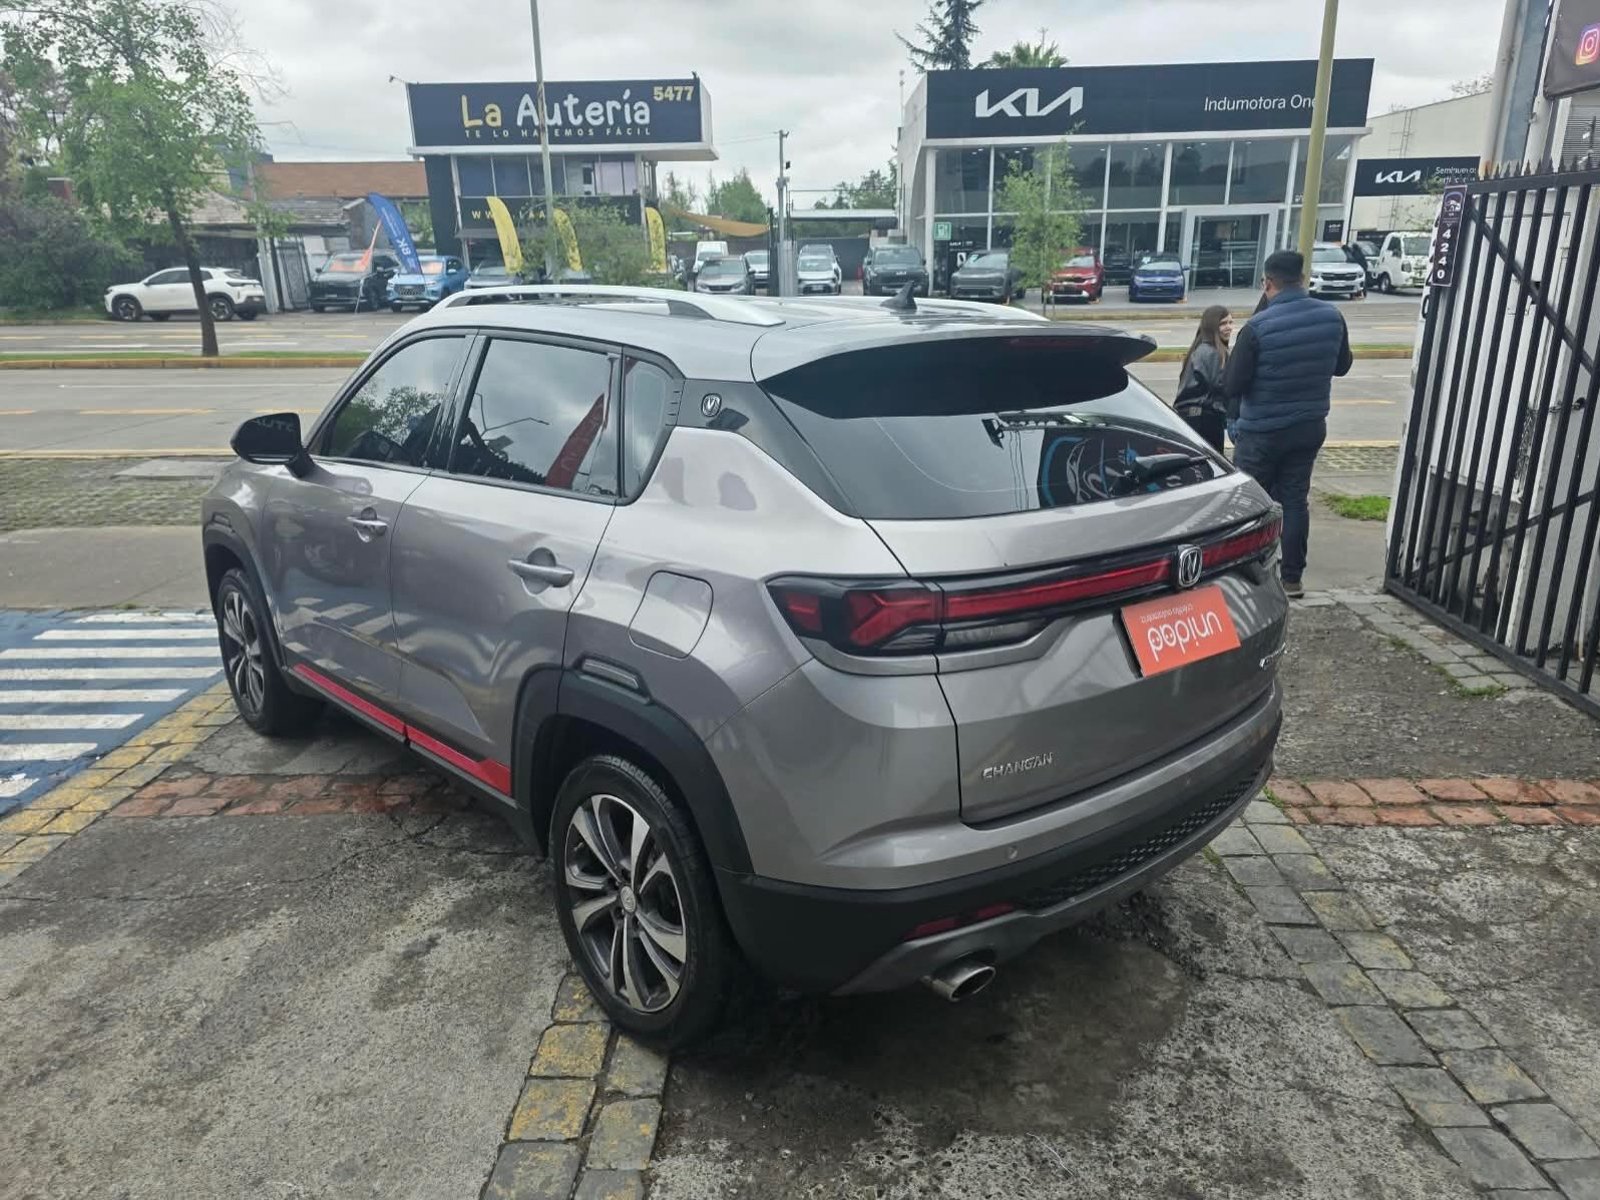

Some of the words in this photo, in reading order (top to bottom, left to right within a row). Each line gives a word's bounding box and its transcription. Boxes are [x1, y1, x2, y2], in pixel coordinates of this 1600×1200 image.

[653, 86, 694, 101] 5477
[976, 87, 1084, 117] KIA
[1204, 96, 1286, 111] Indumotora
[461, 95, 502, 128] La
[516, 88, 650, 126] Autería
[465, 130, 481, 138] TE
[521, 128, 594, 137] HAEMOS
[1375, 170, 1422, 184] KIA
[1437, 229, 1451, 279] 4240
[1147, 610, 1223, 662] unidad
[983, 752, 1053, 779] CHANGAN
